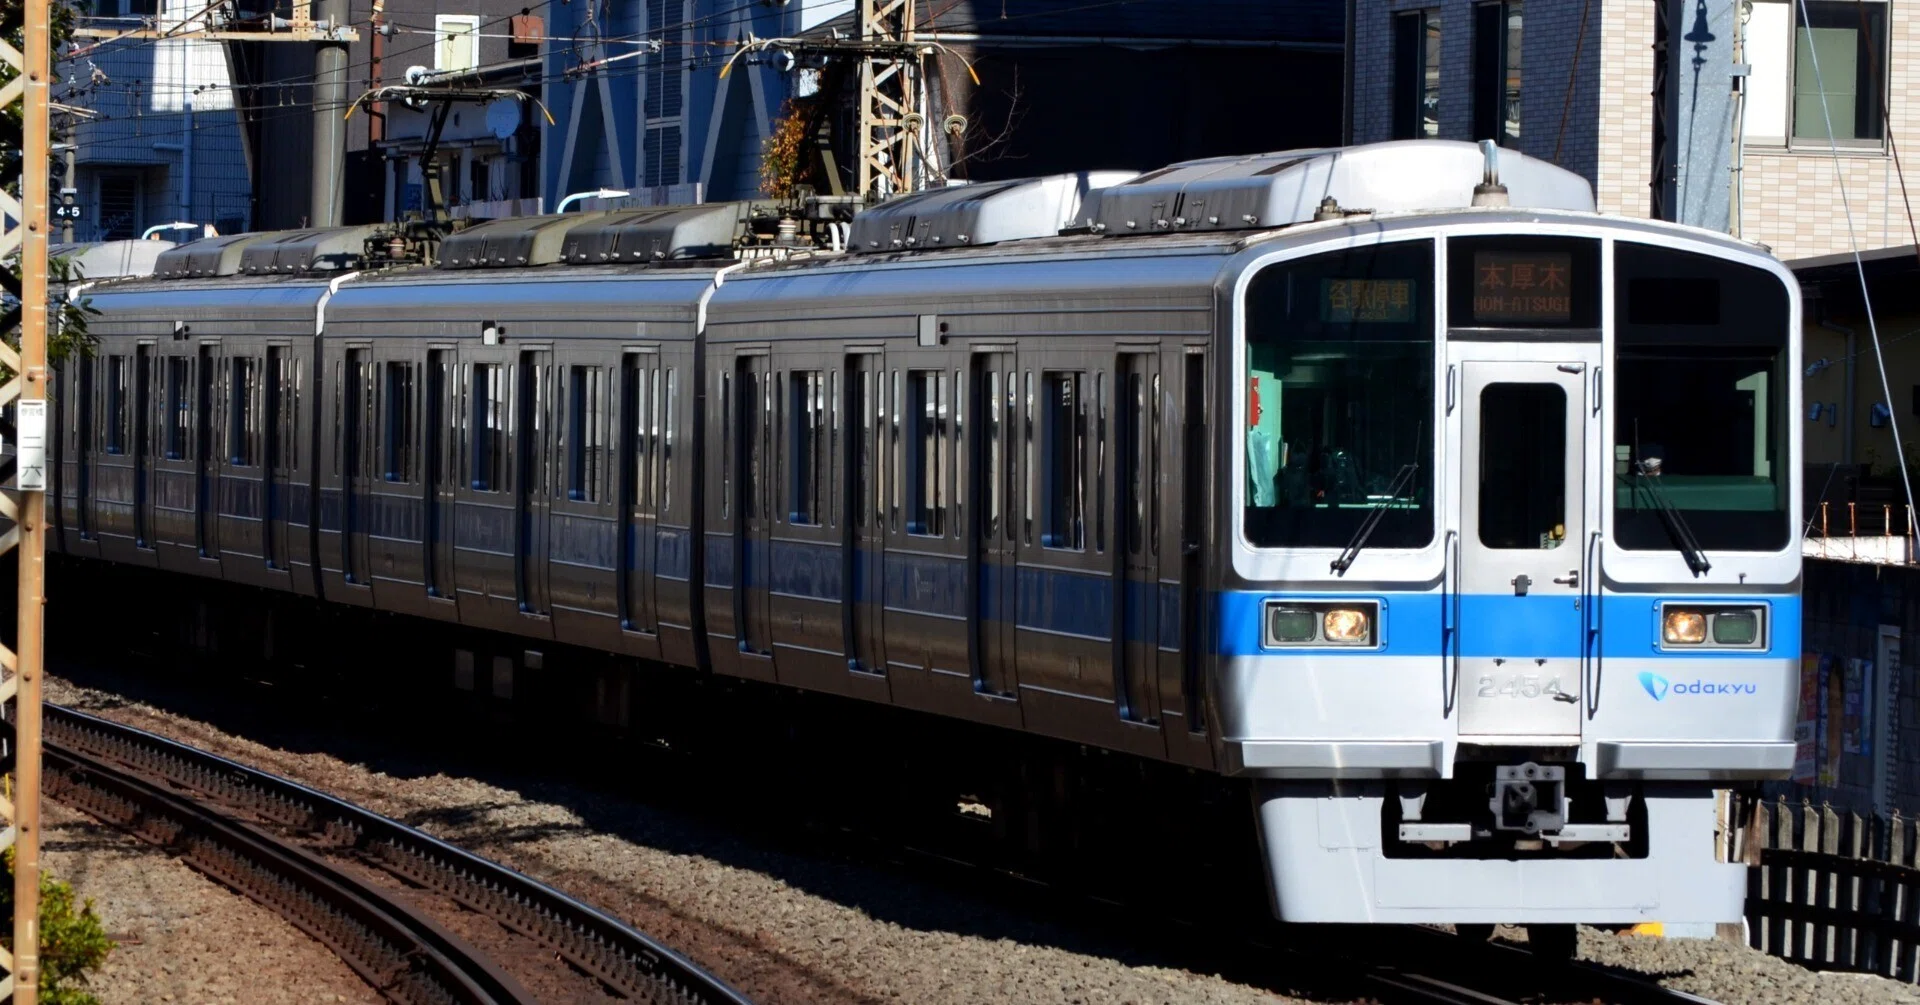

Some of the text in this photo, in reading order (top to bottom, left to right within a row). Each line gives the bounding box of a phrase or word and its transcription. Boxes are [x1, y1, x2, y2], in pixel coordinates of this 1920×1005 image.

[1480, 262, 1565, 290] 本厚木
[1329, 281, 1409, 309] 各駅停車
[1473, 296, 1571, 312] HON-ATSUGI
[1478, 675, 1562, 699] 2454
